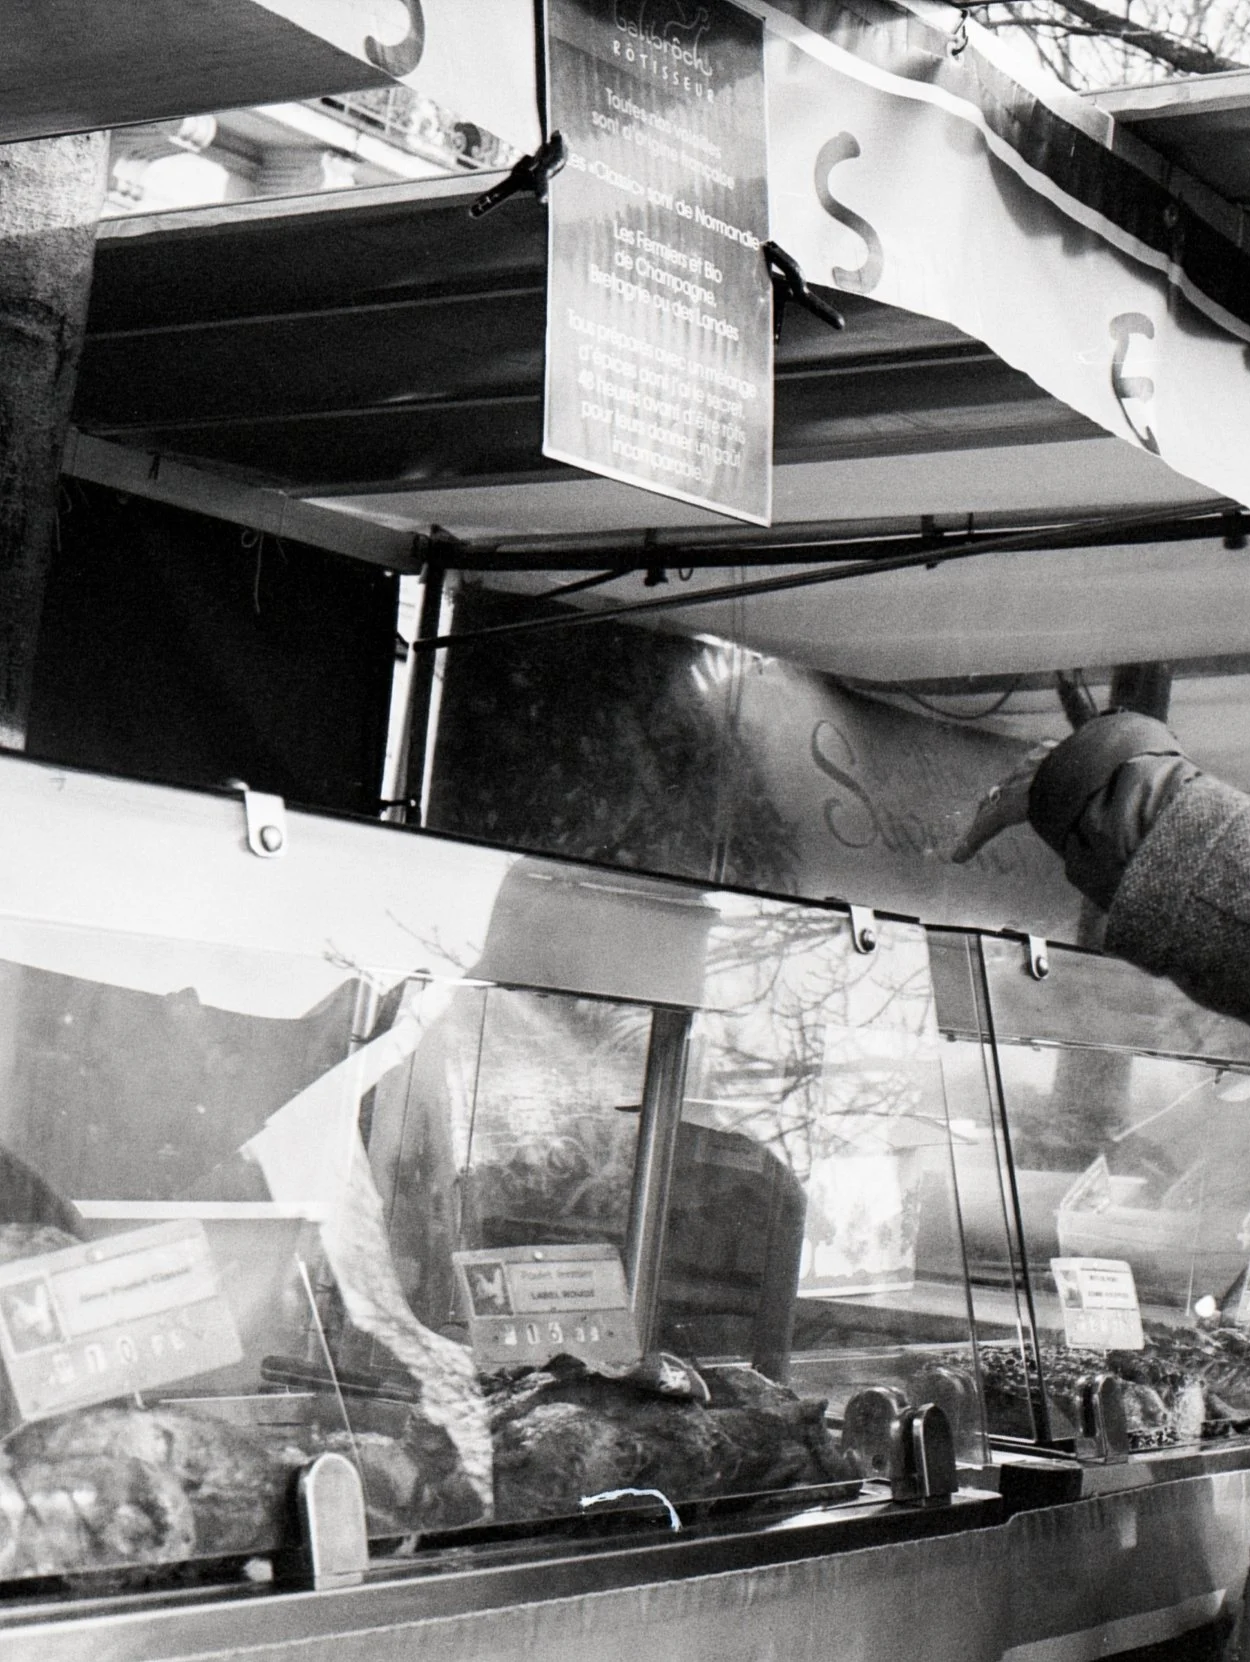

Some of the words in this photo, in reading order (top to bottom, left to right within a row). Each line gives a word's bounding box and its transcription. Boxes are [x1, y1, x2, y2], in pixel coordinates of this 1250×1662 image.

[613, 39, 714, 103] RÔTISSEUR
[592, 110, 619, 135] sont
[605, 87, 648, 122] Toutes
[613, 220, 635, 245] Les
[636, 228, 689, 269] Fermiers
[690, 256, 704, 274] et
[704, 258, 723, 284] Bio
[675, 198, 693, 219] de
[695, 204, 761, 251] Normandie
[589, 263, 652, 304] Bretagne
[653, 294, 671, 312] ou
[672, 300, 695, 324] des
[697, 307, 740, 341] Landes
[614, 249, 634, 272] de
[635, 256, 718, 308] Champagne,
